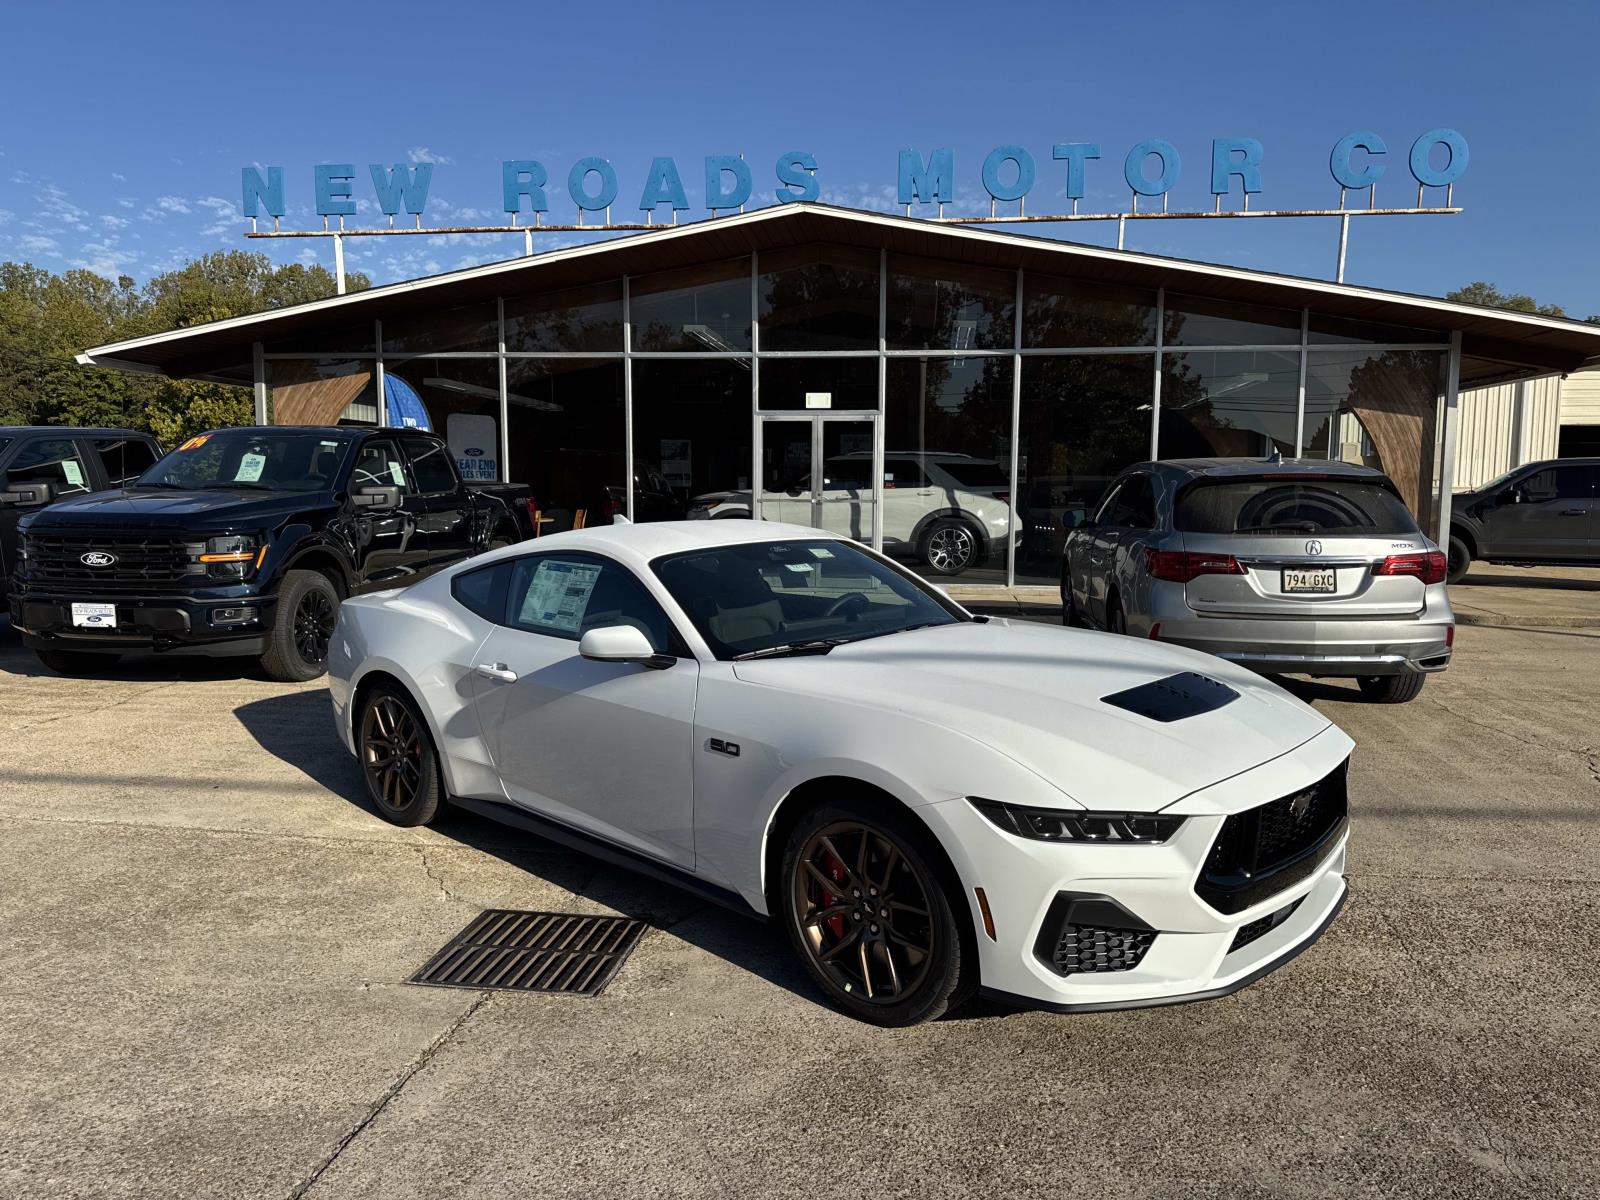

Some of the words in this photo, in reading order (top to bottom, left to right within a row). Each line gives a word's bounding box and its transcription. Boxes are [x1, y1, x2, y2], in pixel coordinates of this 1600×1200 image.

[242, 162, 434, 217] NEW
[503, 151, 820, 213] ROADS
[898, 137, 1264, 204] MOTOR
[1330, 128, 1470, 189] CO
[402, 417, 417, 427] TWO
[480, 460, 496, 470] END
[476, 471, 495, 479] EVENT
[1286, 574, 1307, 586] 794
[1313, 574, 1334, 586] GXC
